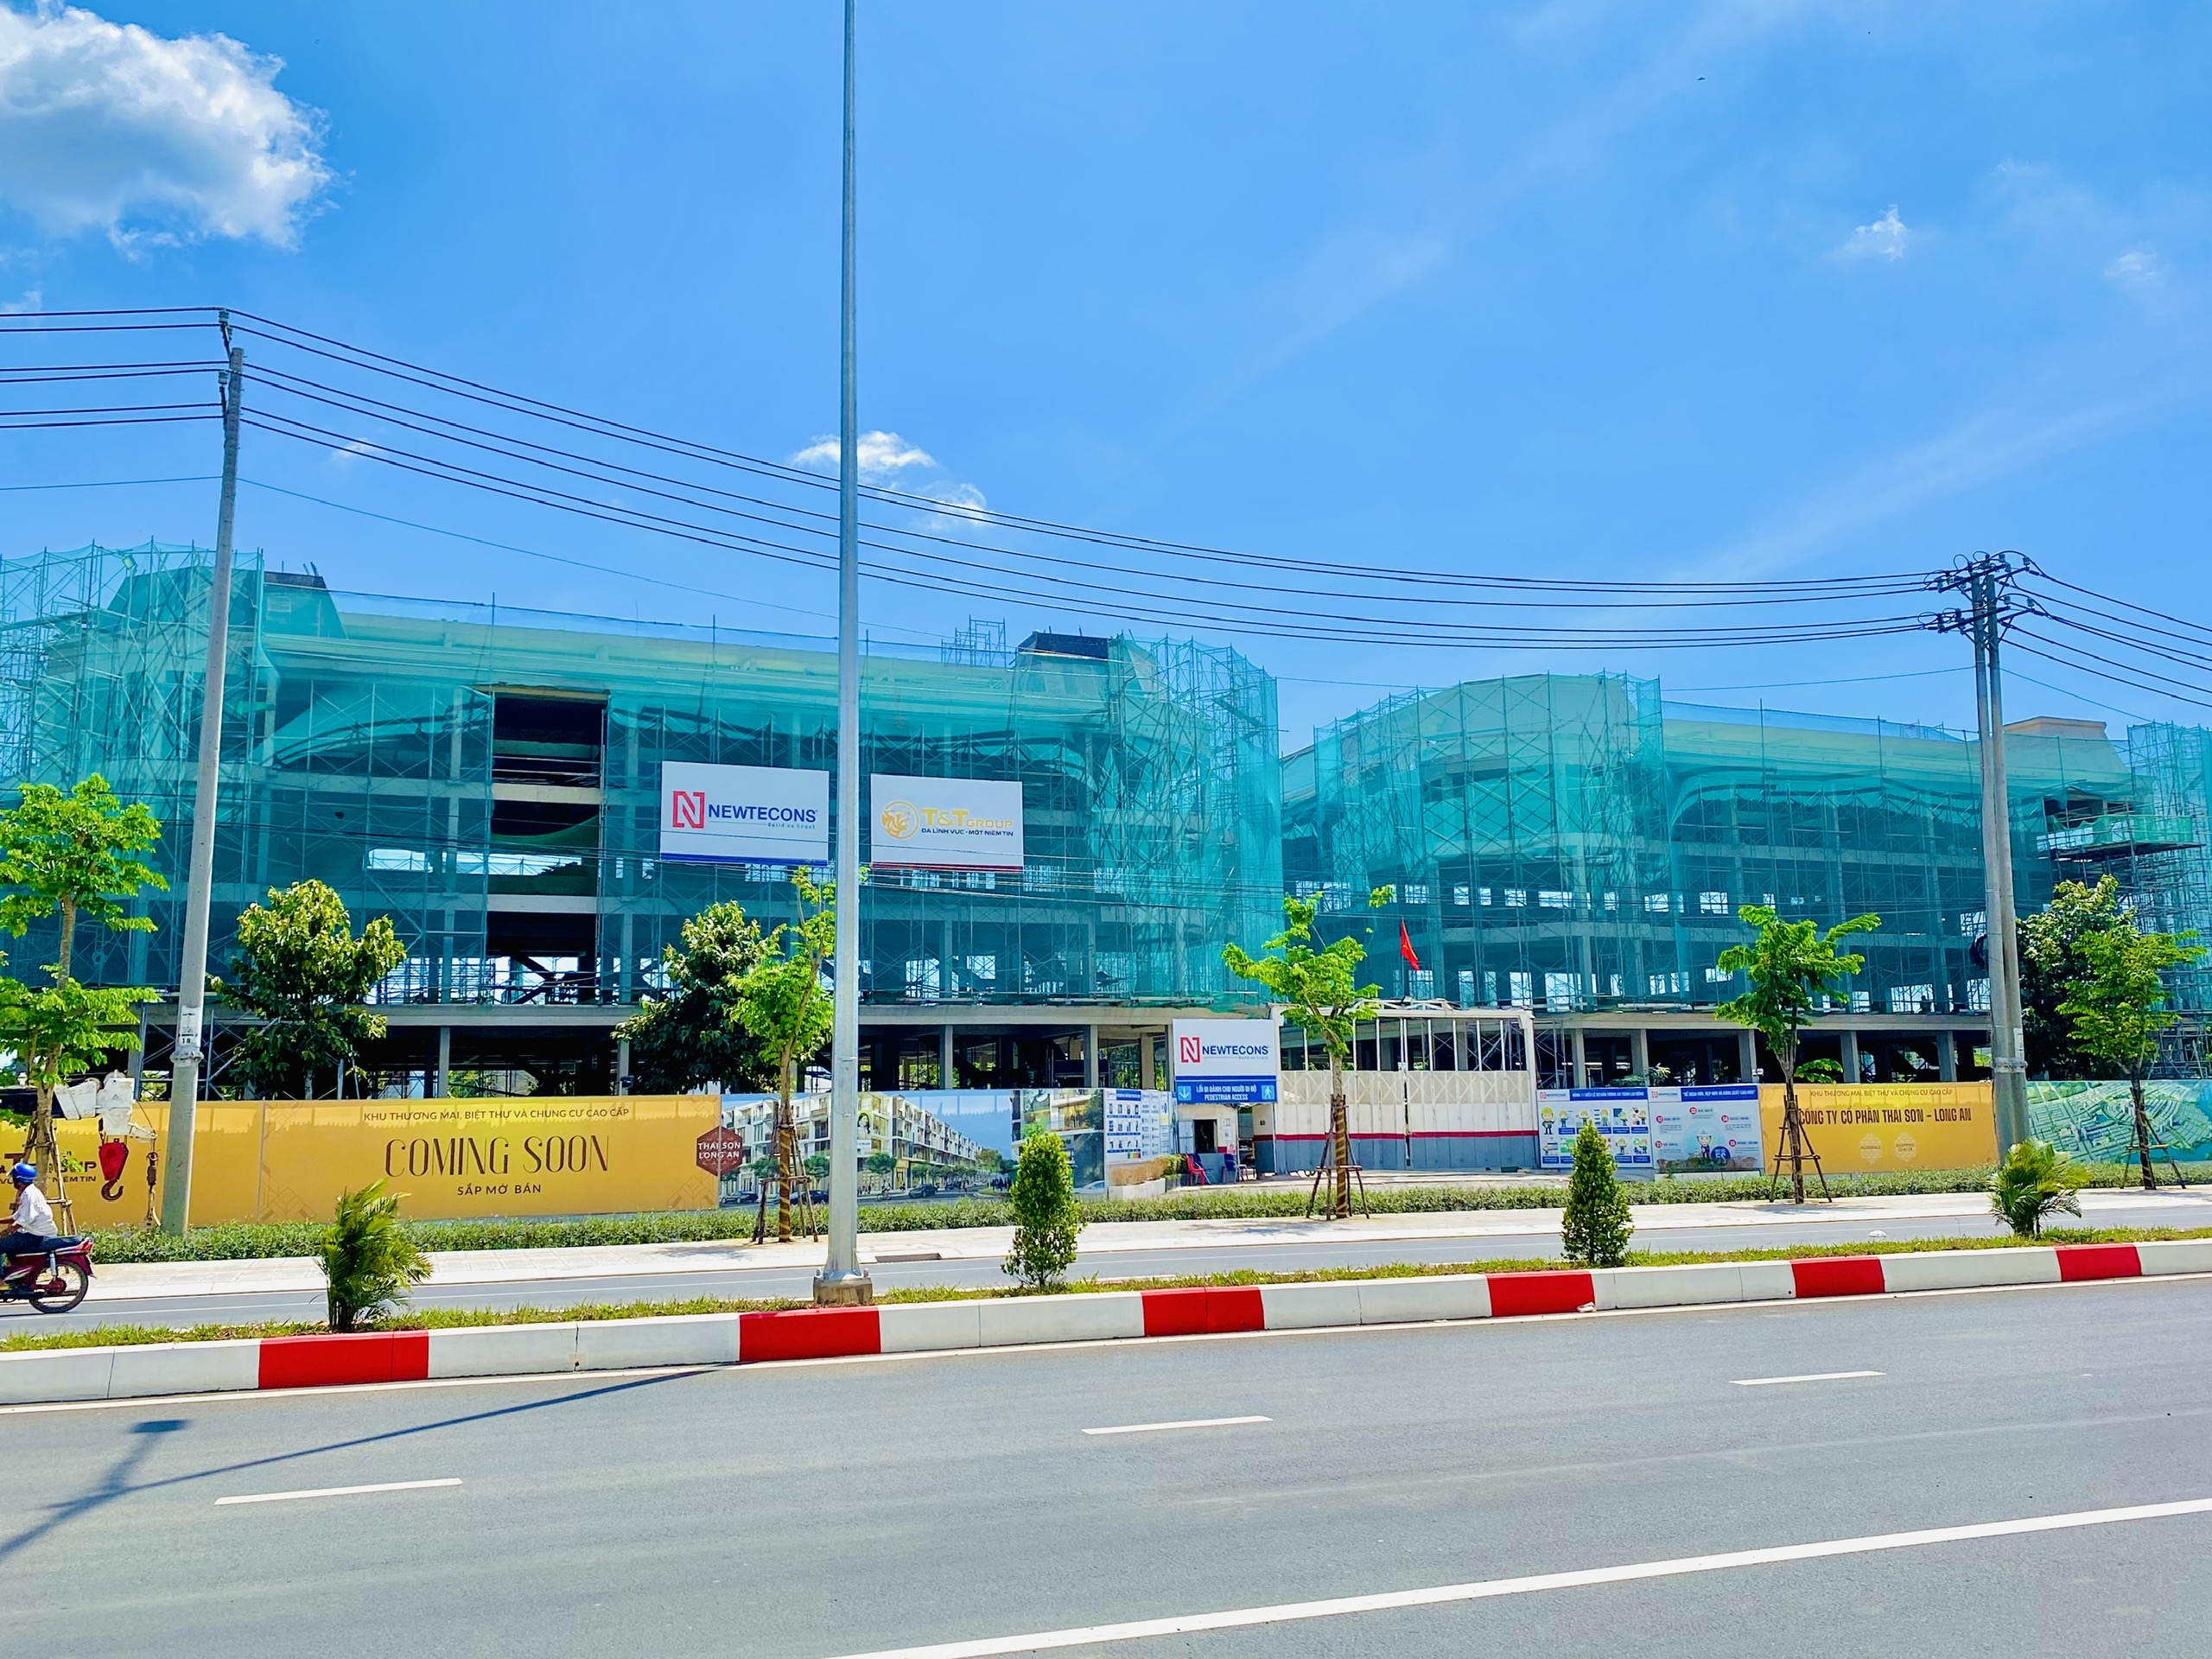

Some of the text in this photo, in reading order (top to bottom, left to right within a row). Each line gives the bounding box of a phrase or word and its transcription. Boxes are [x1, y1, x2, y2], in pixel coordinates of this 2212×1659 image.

[709, 804, 816, 823] NEWTECONS
[921, 808, 1014, 829] T&T GROUP
[1202, 1046, 1268, 1055] NEWTECONS
[364, 1112, 386, 1122] KHU
[389, 1111, 437, 1121] THƯƠNG
[464, 1109, 486, 1121] BIỆT
[489, 1109, 511, 1120] THỰ
[513, 1109, 528, 1118] VÀ
[530, 1109, 566, 1118] CHUNG
[569, 1109, 585, 1117] CƯ
[586, 1109, 607, 1117] CAO
[609, 1106, 629, 1117] CẤP
[1800, 1107, 1824, 1124] CÔNG
[1826, 1109, 1837, 1124] TY
[1840, 1105, 1853, 1124] CỔ
[1855, 1105, 1879, 1123] PHẦN
[1904, 1108, 1923, 1122] SƠN
[1934, 1108, 1957, 1122] LONG
[1959, 1107, 1972, 1121] AN
[385, 1135, 609, 1178] COMING SOON
[457, 1182, 542, 1196] SẮP MỞ BÁN
